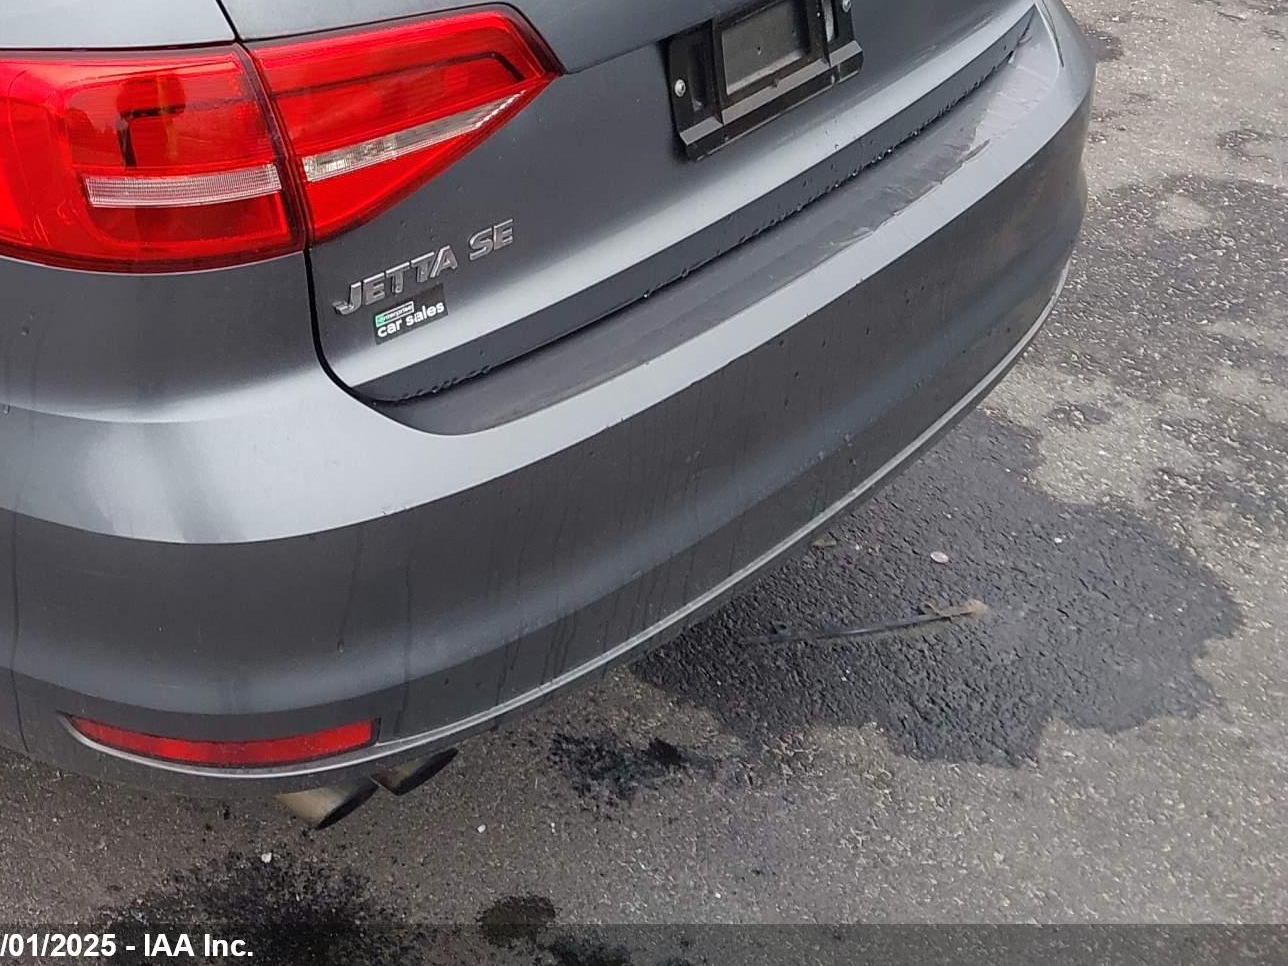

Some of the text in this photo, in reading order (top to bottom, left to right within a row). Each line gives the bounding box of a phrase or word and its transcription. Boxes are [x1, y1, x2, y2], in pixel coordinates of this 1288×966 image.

[331, 218, 514, 316] JETTA SE
[377, 301, 445, 338] car sales
